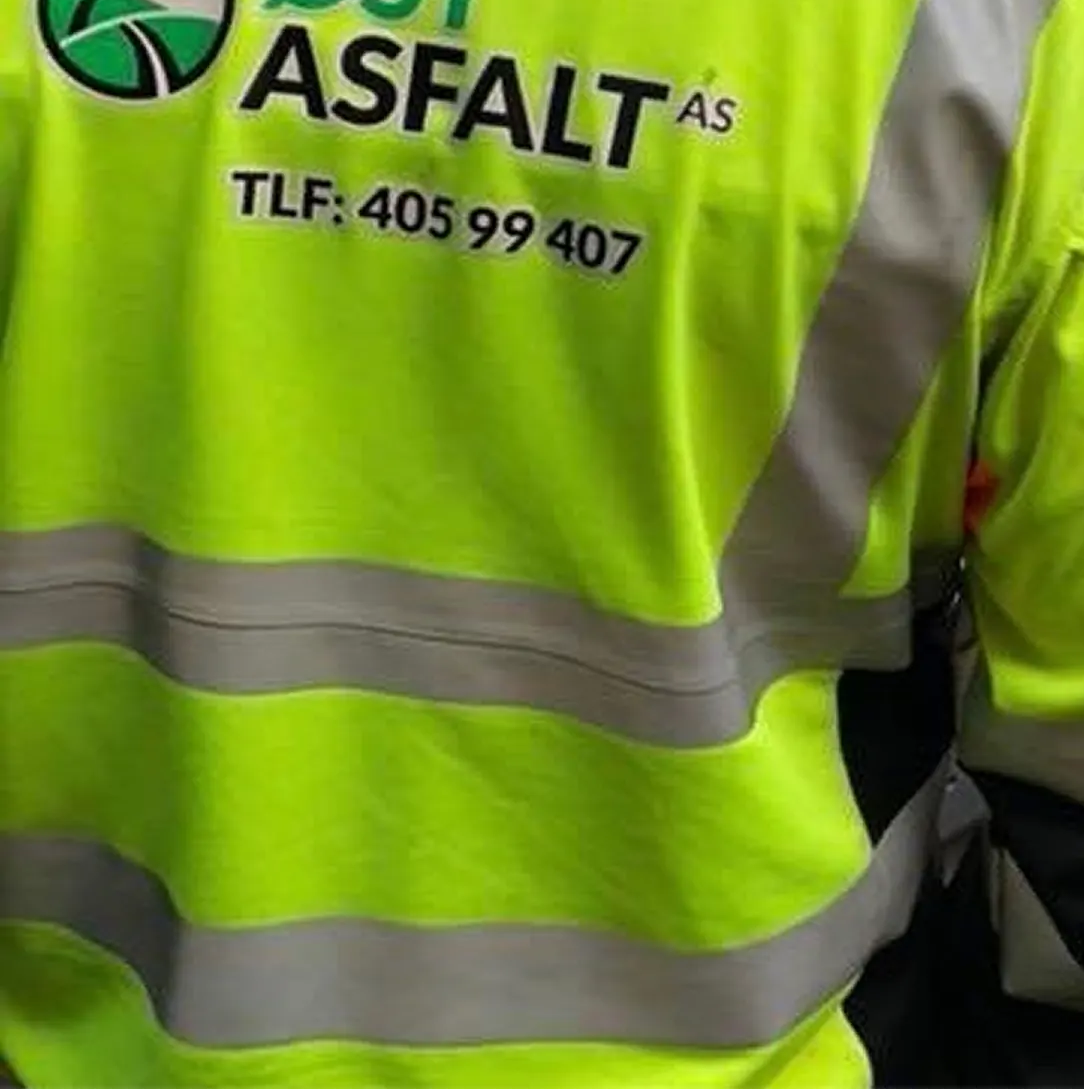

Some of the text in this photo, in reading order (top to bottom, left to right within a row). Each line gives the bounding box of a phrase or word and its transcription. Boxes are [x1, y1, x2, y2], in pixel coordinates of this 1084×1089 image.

[239, 24, 736, 169] ASFALT AS
[232, 170, 643, 276] TLF: 405 99 407
